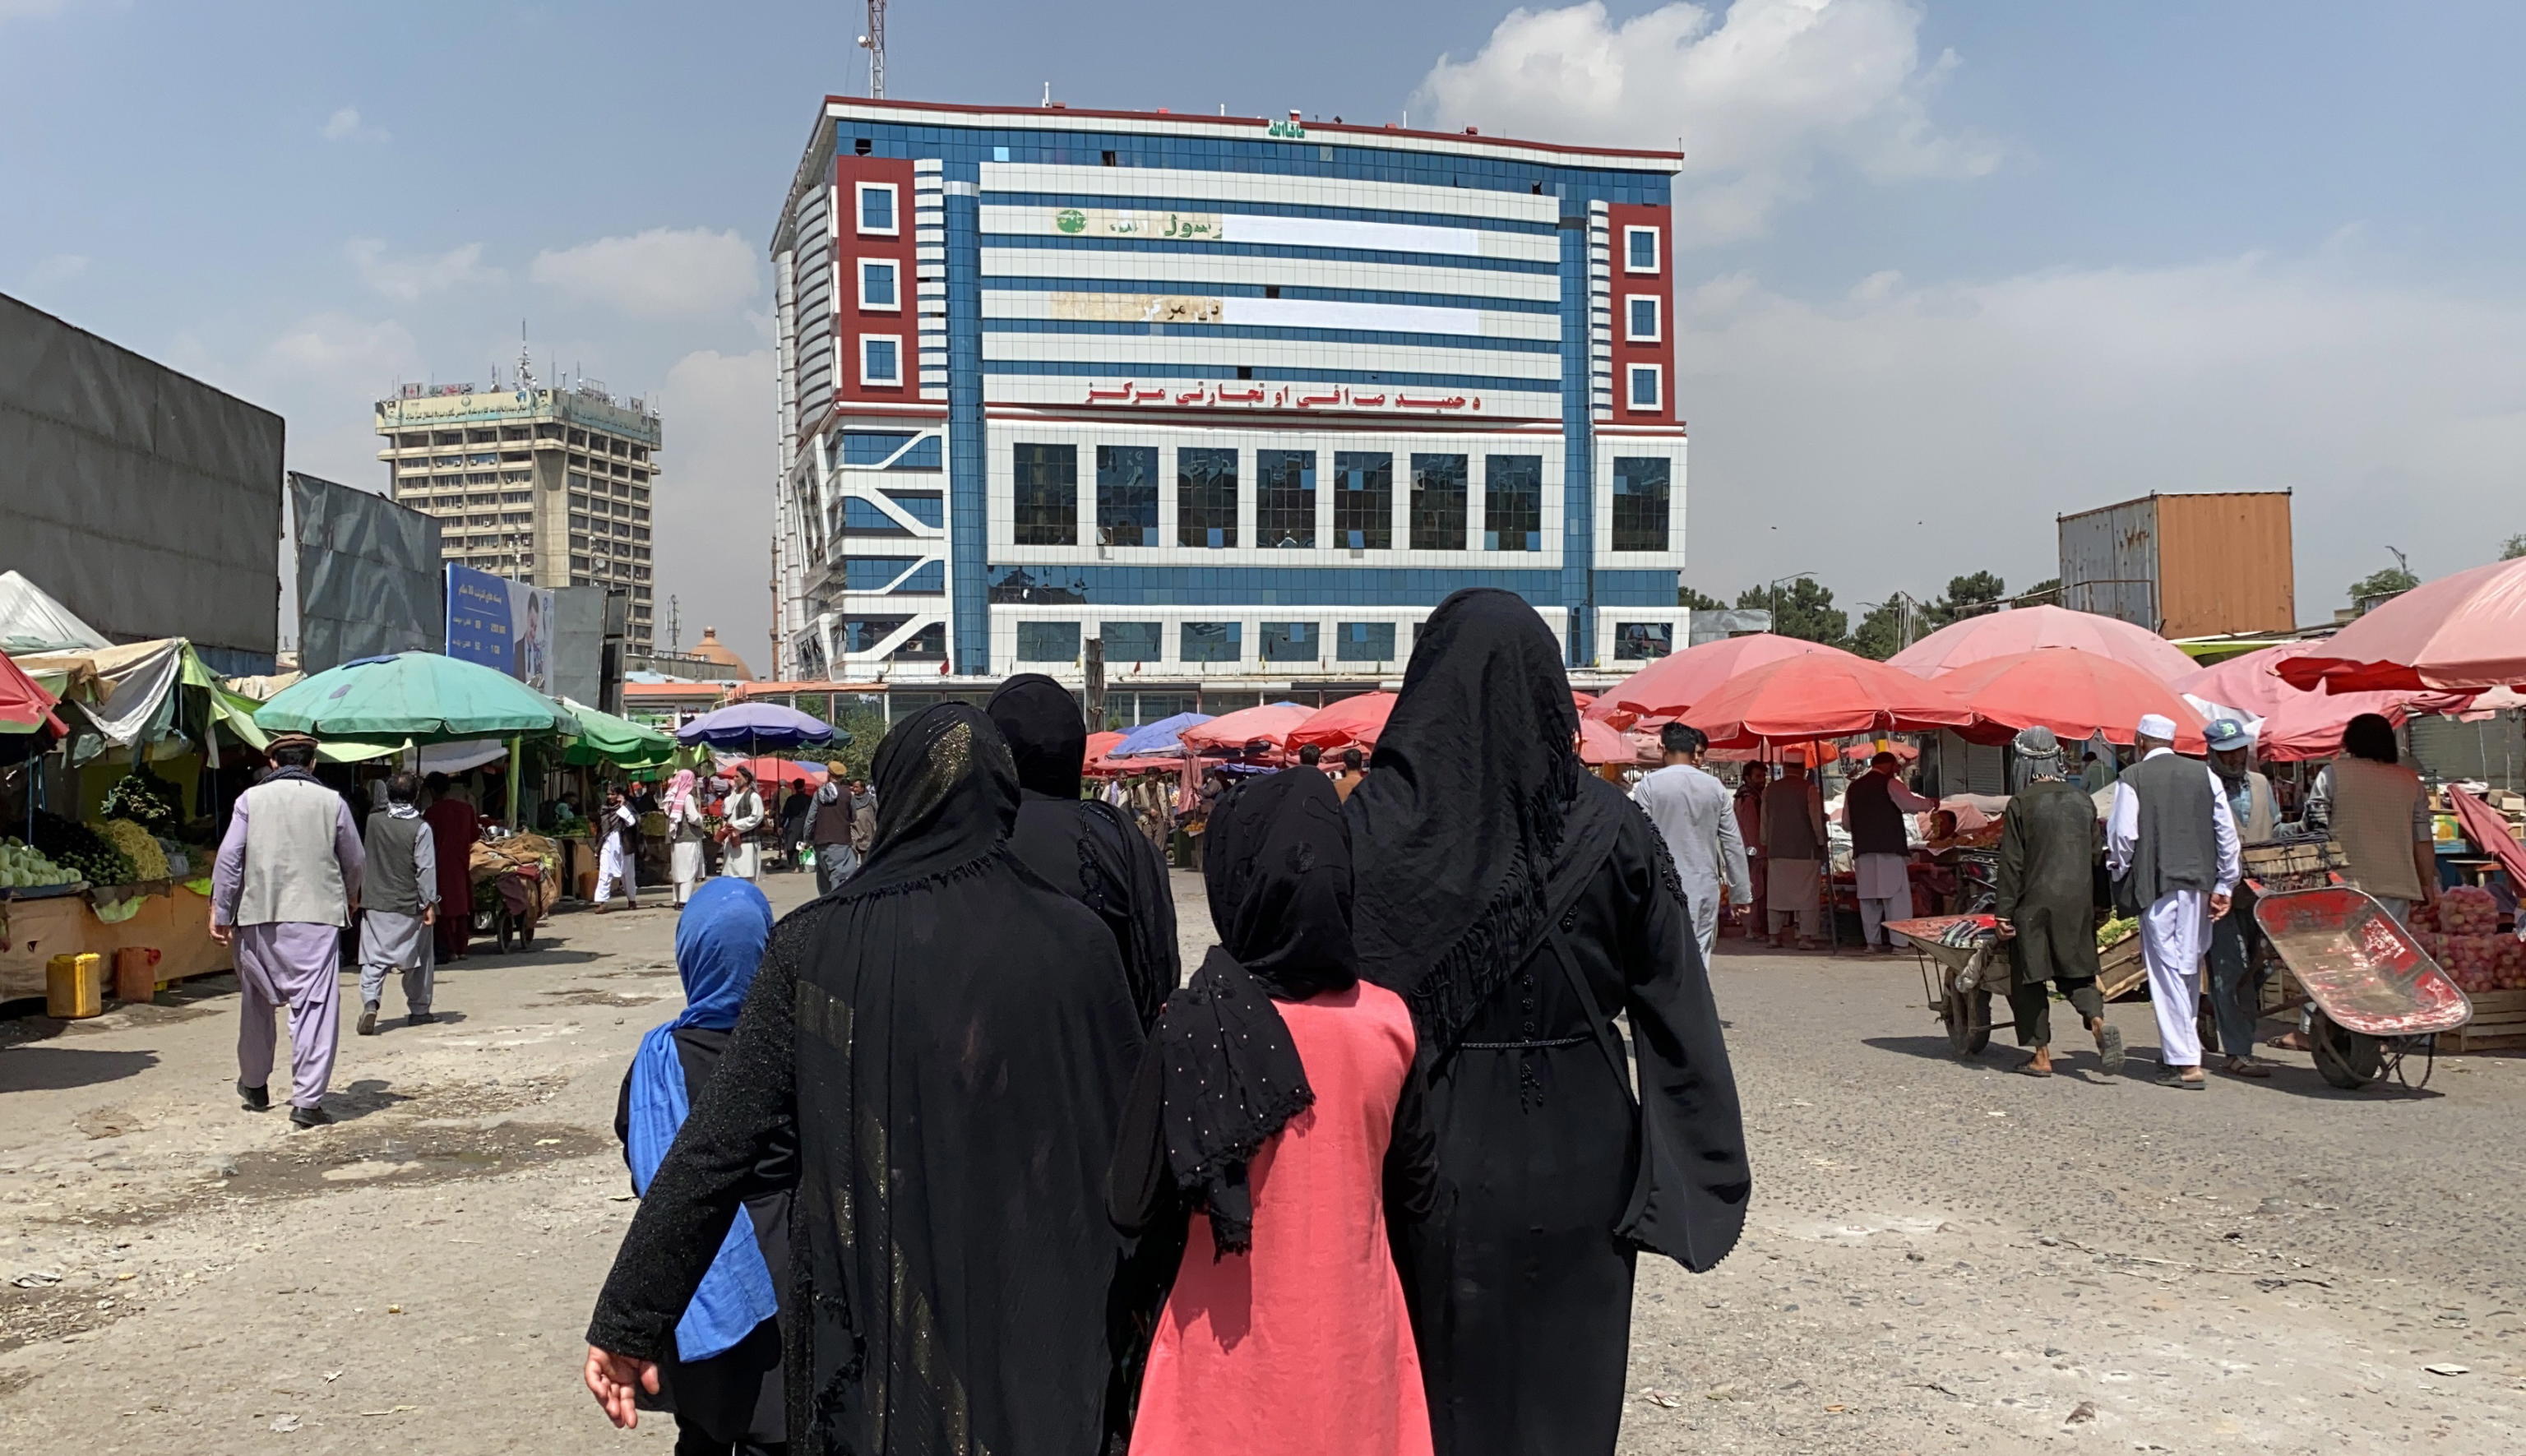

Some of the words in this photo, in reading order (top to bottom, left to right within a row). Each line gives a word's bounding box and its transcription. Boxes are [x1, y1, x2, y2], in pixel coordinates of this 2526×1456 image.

[1085, 381, 1165, 404] مرکز
[1176, 381, 1265, 408] تجارتی
[1274, 385, 1288, 408] او
